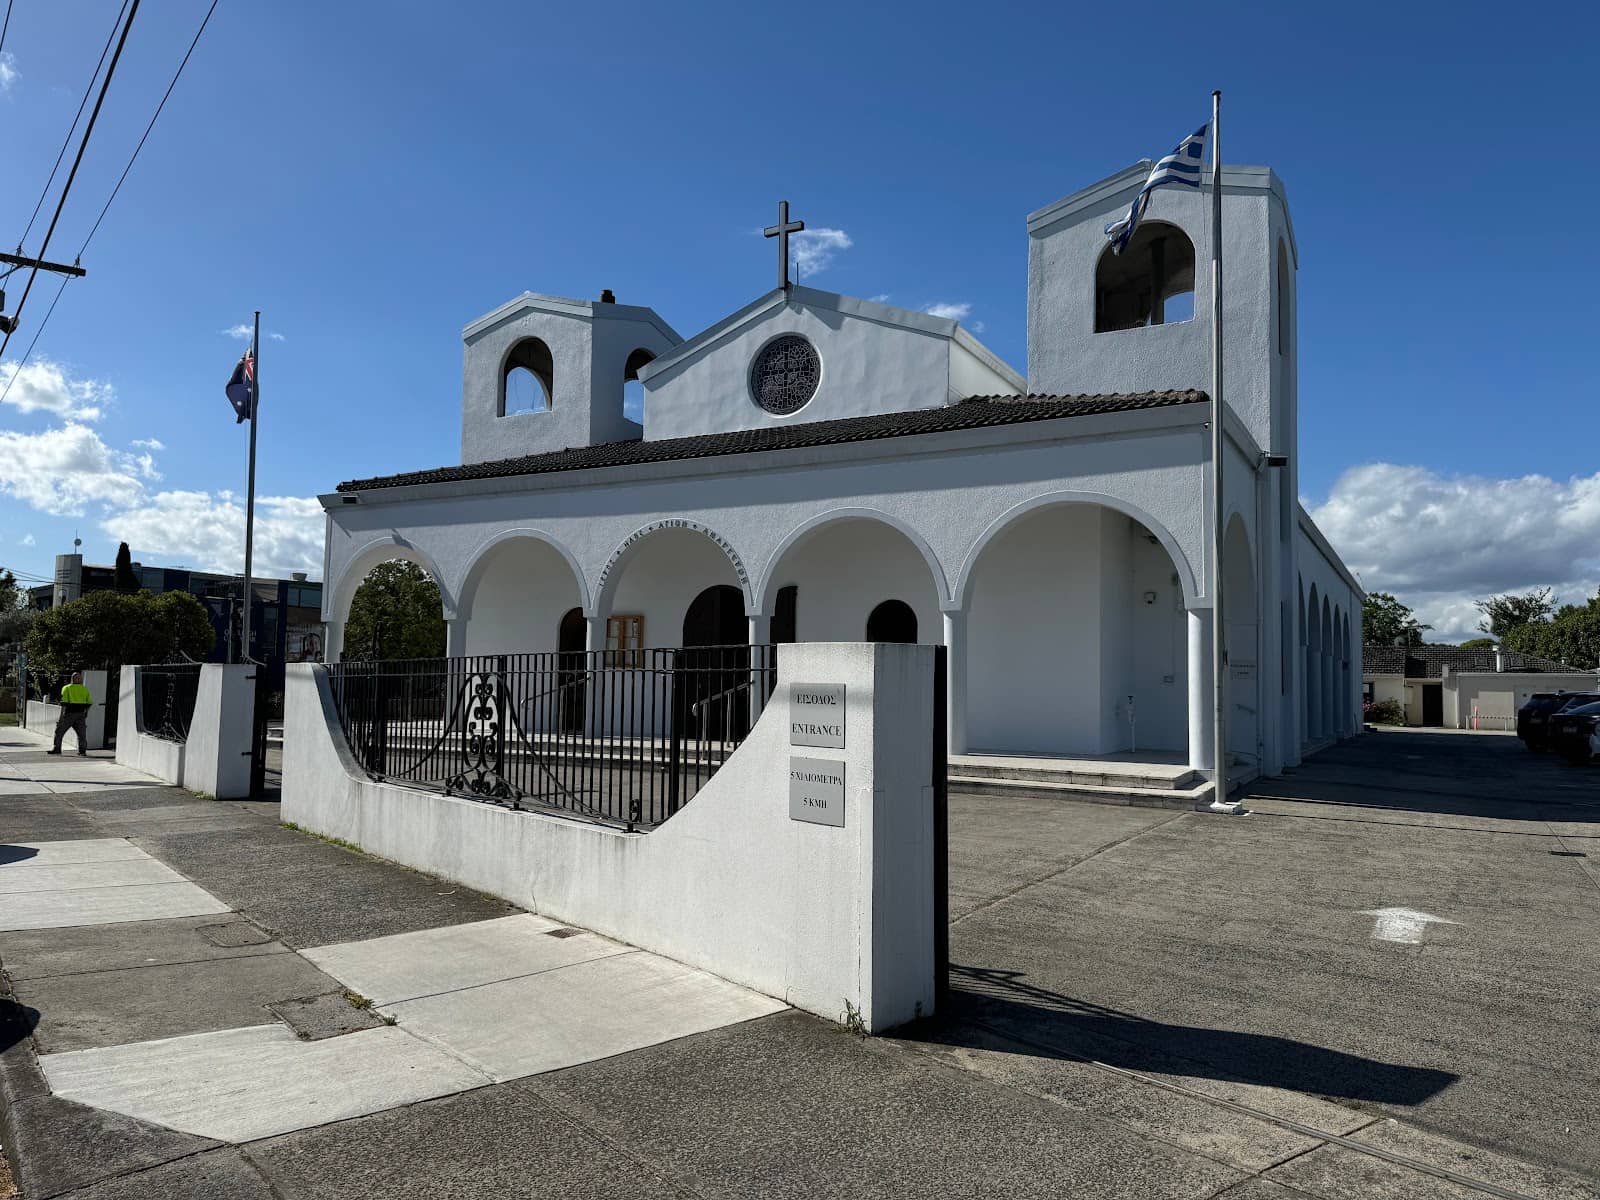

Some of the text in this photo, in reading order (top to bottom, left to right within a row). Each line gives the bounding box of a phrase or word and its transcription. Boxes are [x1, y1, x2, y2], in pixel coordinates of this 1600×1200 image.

[792, 722, 842, 737] ENTRANCE
[803, 797, 828, 809] 5 KMH
